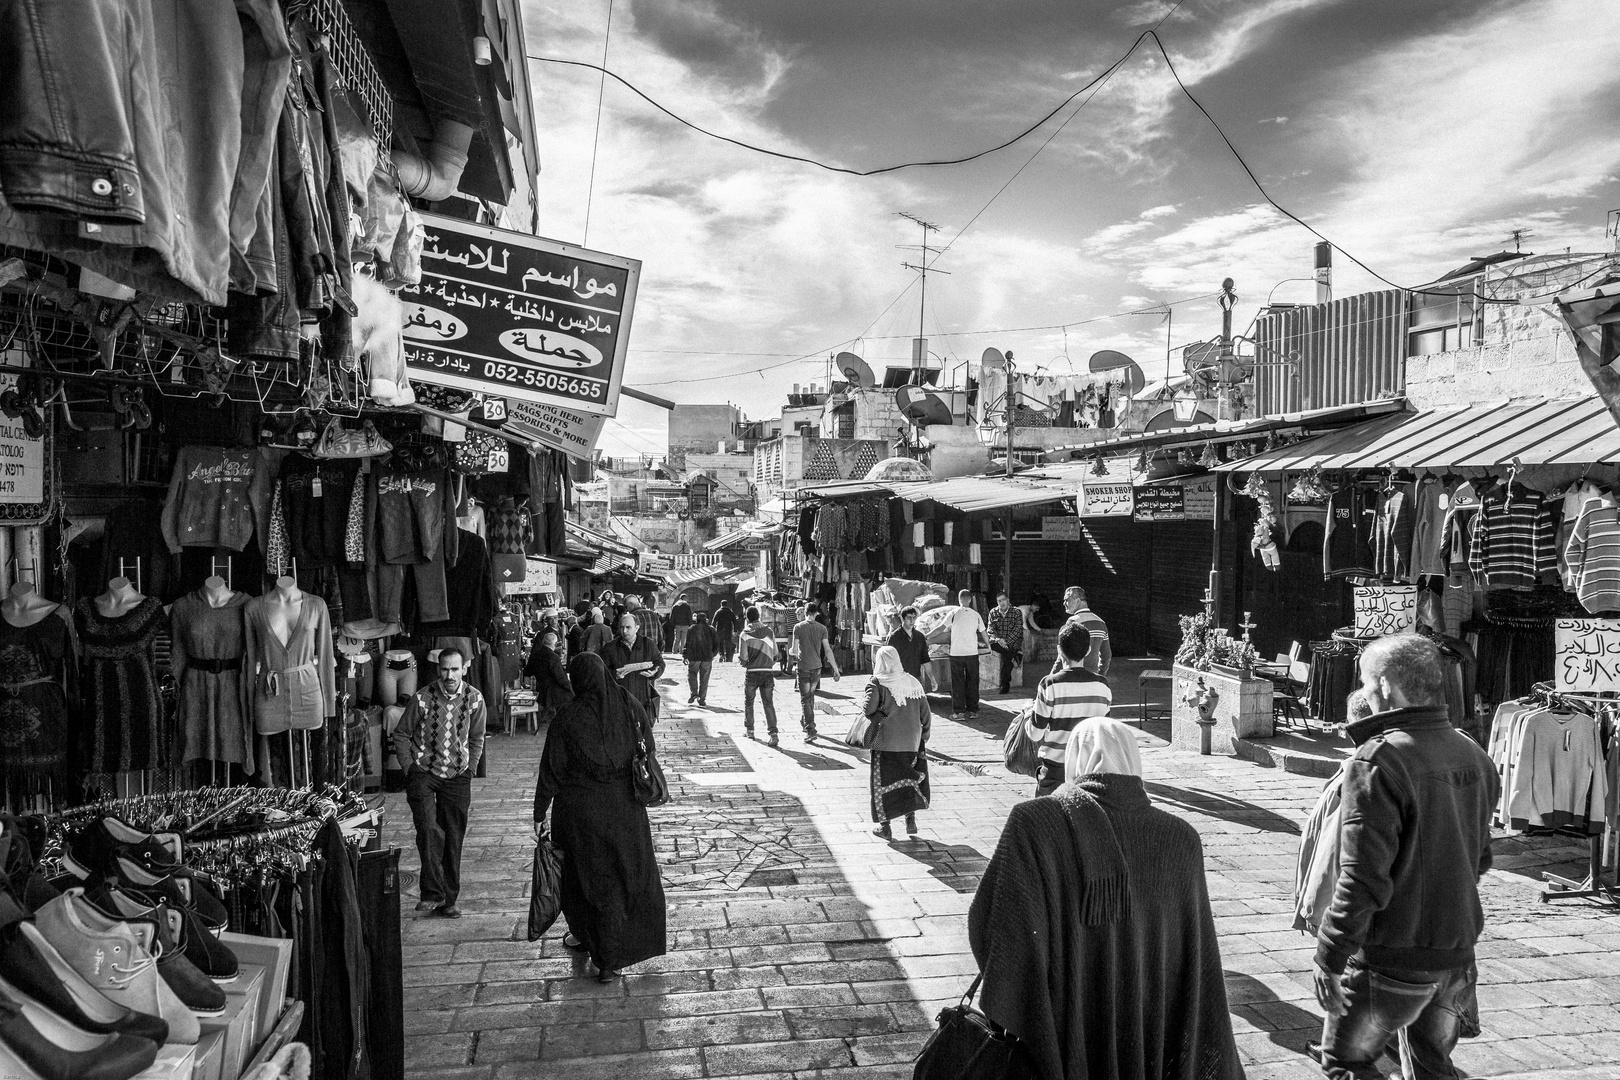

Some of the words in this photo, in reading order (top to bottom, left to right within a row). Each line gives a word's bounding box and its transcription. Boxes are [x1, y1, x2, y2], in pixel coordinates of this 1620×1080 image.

[420, 234, 510, 275] للاست
[522, 265, 617, 299] مواسم
[436, 280, 487, 309] احذية
[504, 294, 555, 323] داخلية
[402, 306, 457, 338] ومفر
[558, 314, 612, 335] ملابس
[511, 331, 592, 367] جملة
[483, 361, 601, 398] 052-5505655
[485, 401, 504, 419] 30
[559, 410, 584, 426] HERE
[507, 409, 552, 432] ESSORIES
[552, 427, 562, 436] &
[562, 431, 589, 447] MORE
[488, 453, 506, 469] 30
[1085, 487, 1114, 496] SMOKER
[1115, 486, 1132, 494] SHOP
[1087, 495, 1113, 506] المدخن
[1113, 495, 1131, 505] دكان
[1137, 488, 1158, 499] القدس
[1336, 508, 1350, 519] 75
[1389, 594, 1415, 612] على
